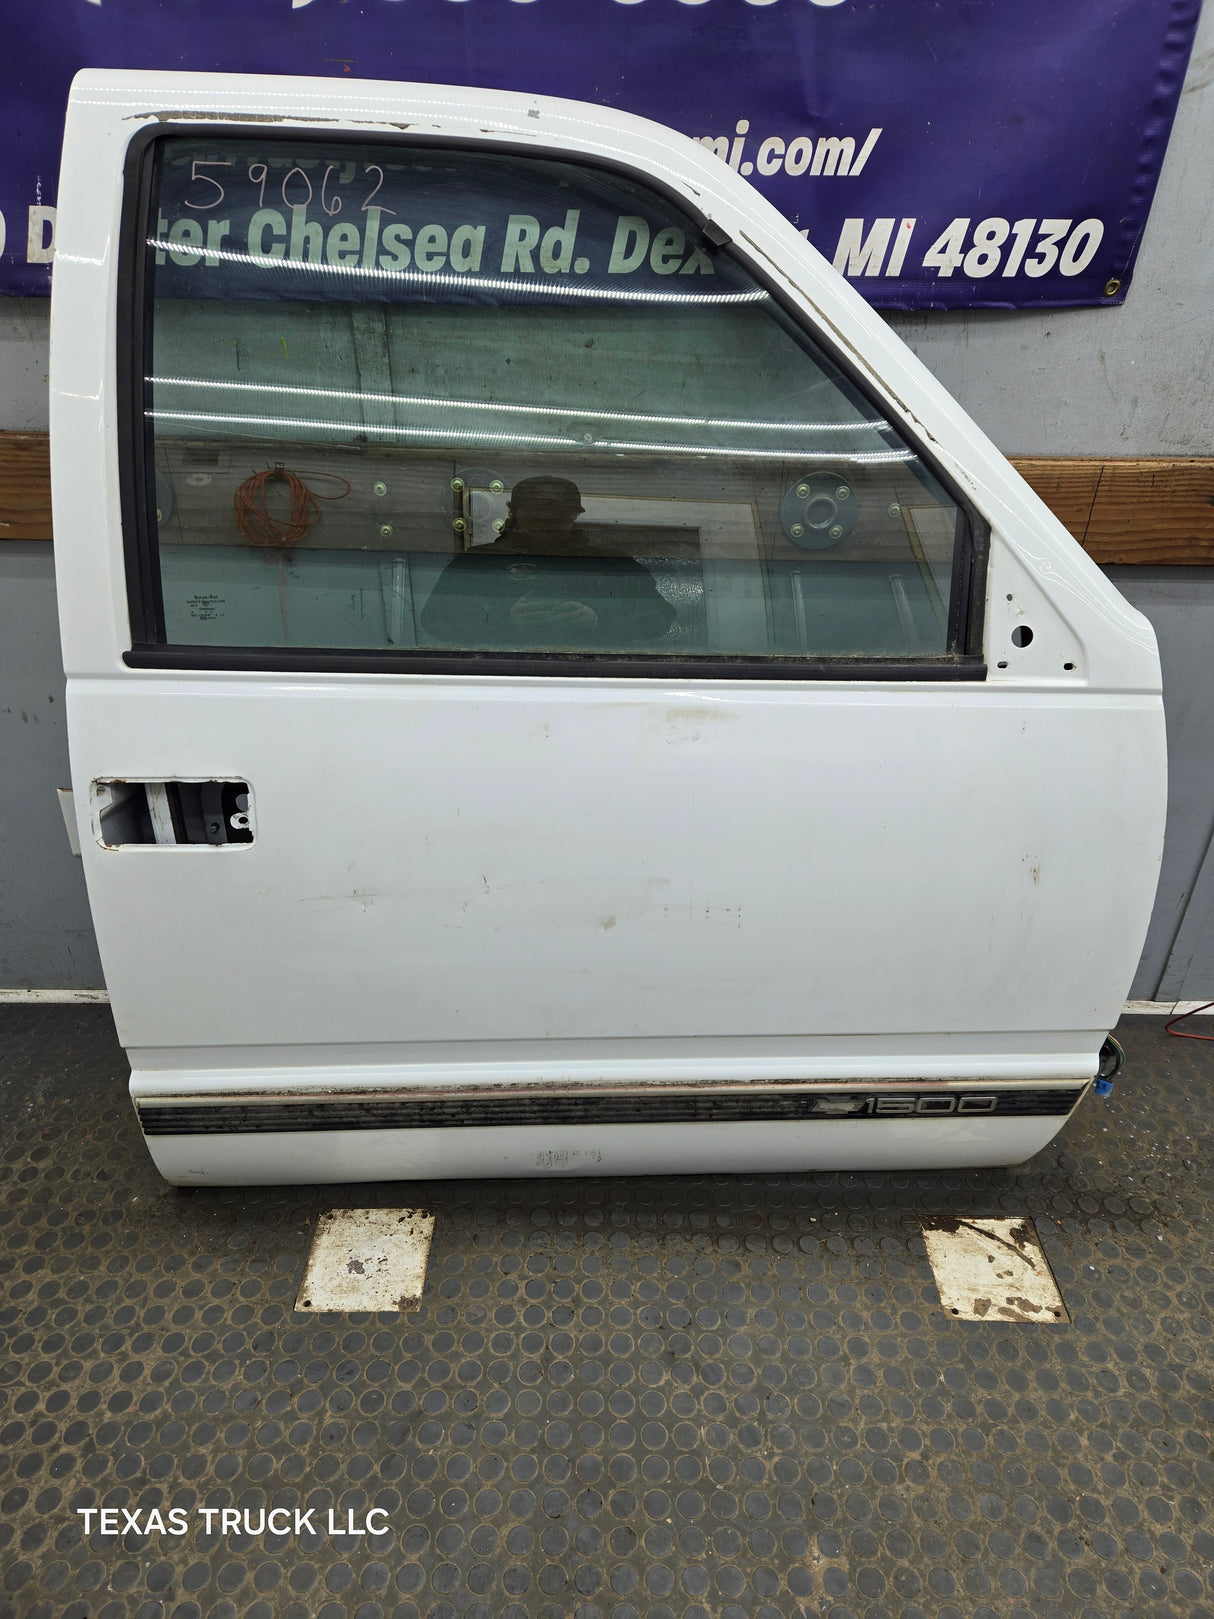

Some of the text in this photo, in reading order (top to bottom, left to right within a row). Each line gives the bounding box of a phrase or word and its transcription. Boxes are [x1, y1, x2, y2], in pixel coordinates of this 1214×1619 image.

[185, 161, 397, 216] 59062
[248, 203, 486, 273] Chelsea
[500, 209, 590, 274] Rd.
[832, 217, 917, 277] MI
[922, 217, 1105, 278] 48130
[865, 1096, 997, 1114] 1500
